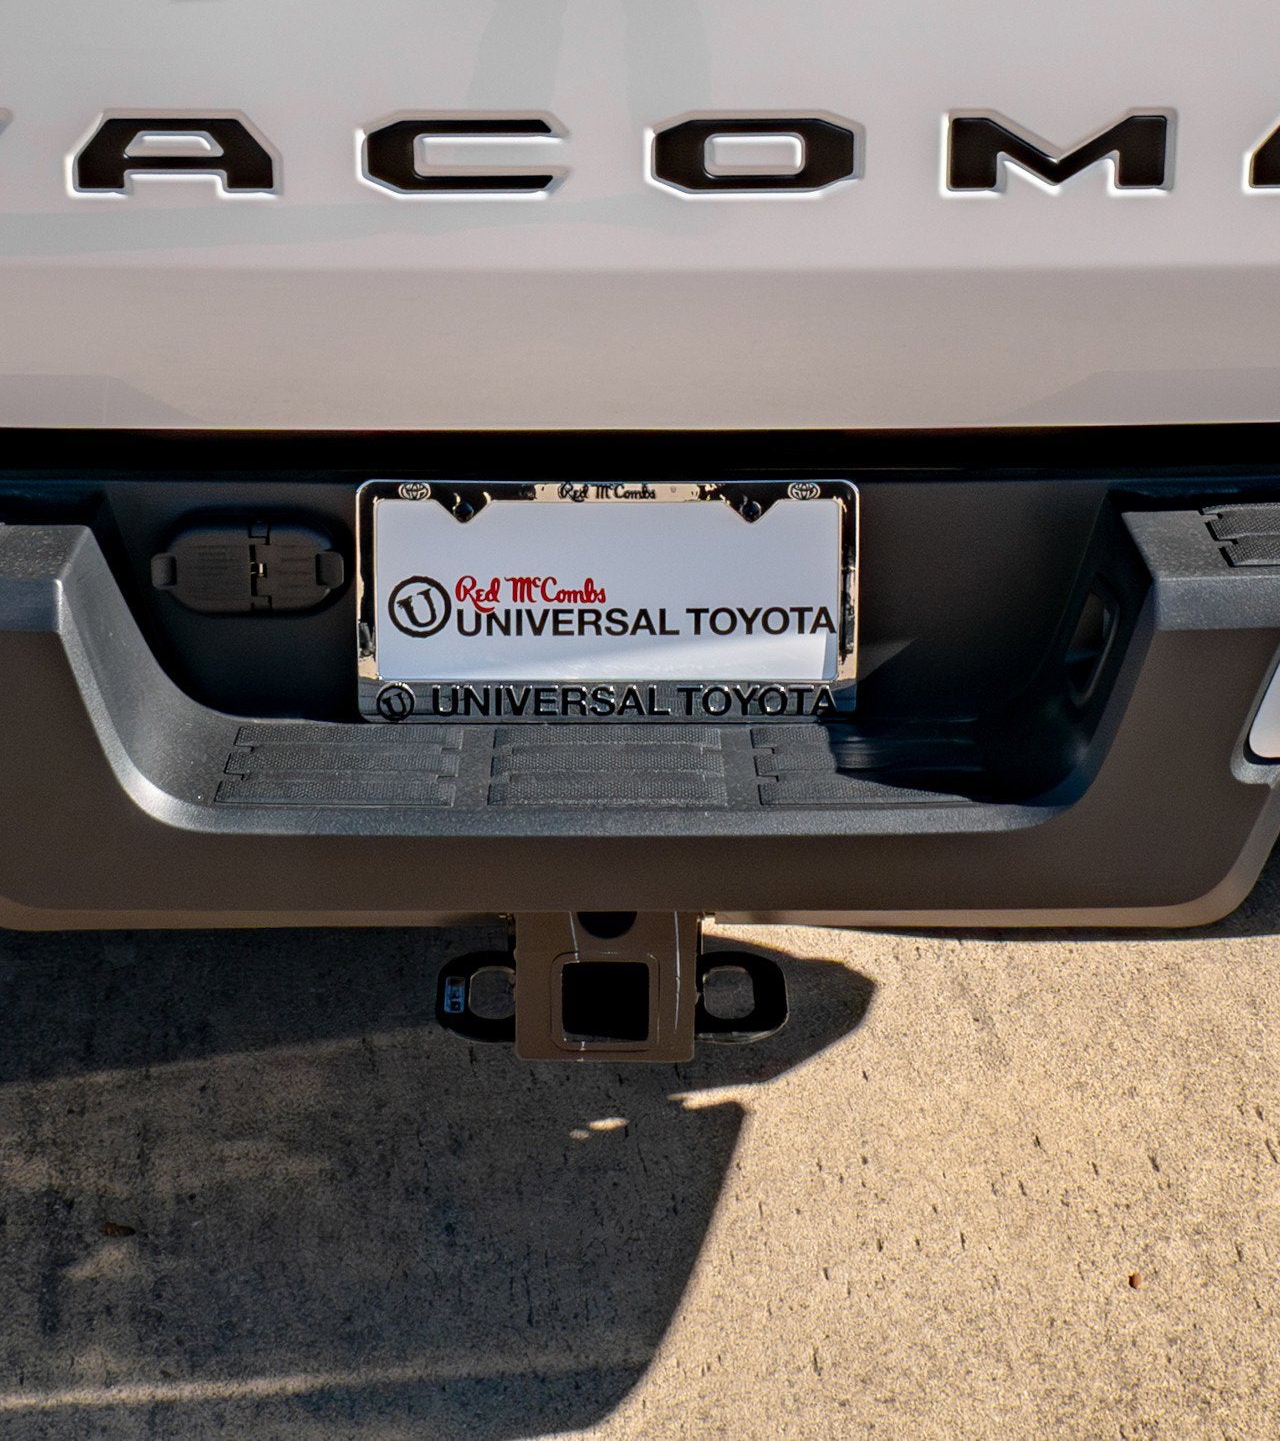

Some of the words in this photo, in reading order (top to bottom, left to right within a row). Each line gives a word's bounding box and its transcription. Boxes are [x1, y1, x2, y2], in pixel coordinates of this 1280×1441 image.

[557, 480, 589, 503] Red
[590, 480, 657, 500] McCombs
[455, 575, 500, 614] Red
[504, 576, 607, 604] McCombs
[456, 608, 680, 637] UNIVERSAL
[685, 606, 837, 636] TOYOTA
[431, 685, 671, 718] UNIVERSAL
[678, 685, 838, 718] TOYOTA
